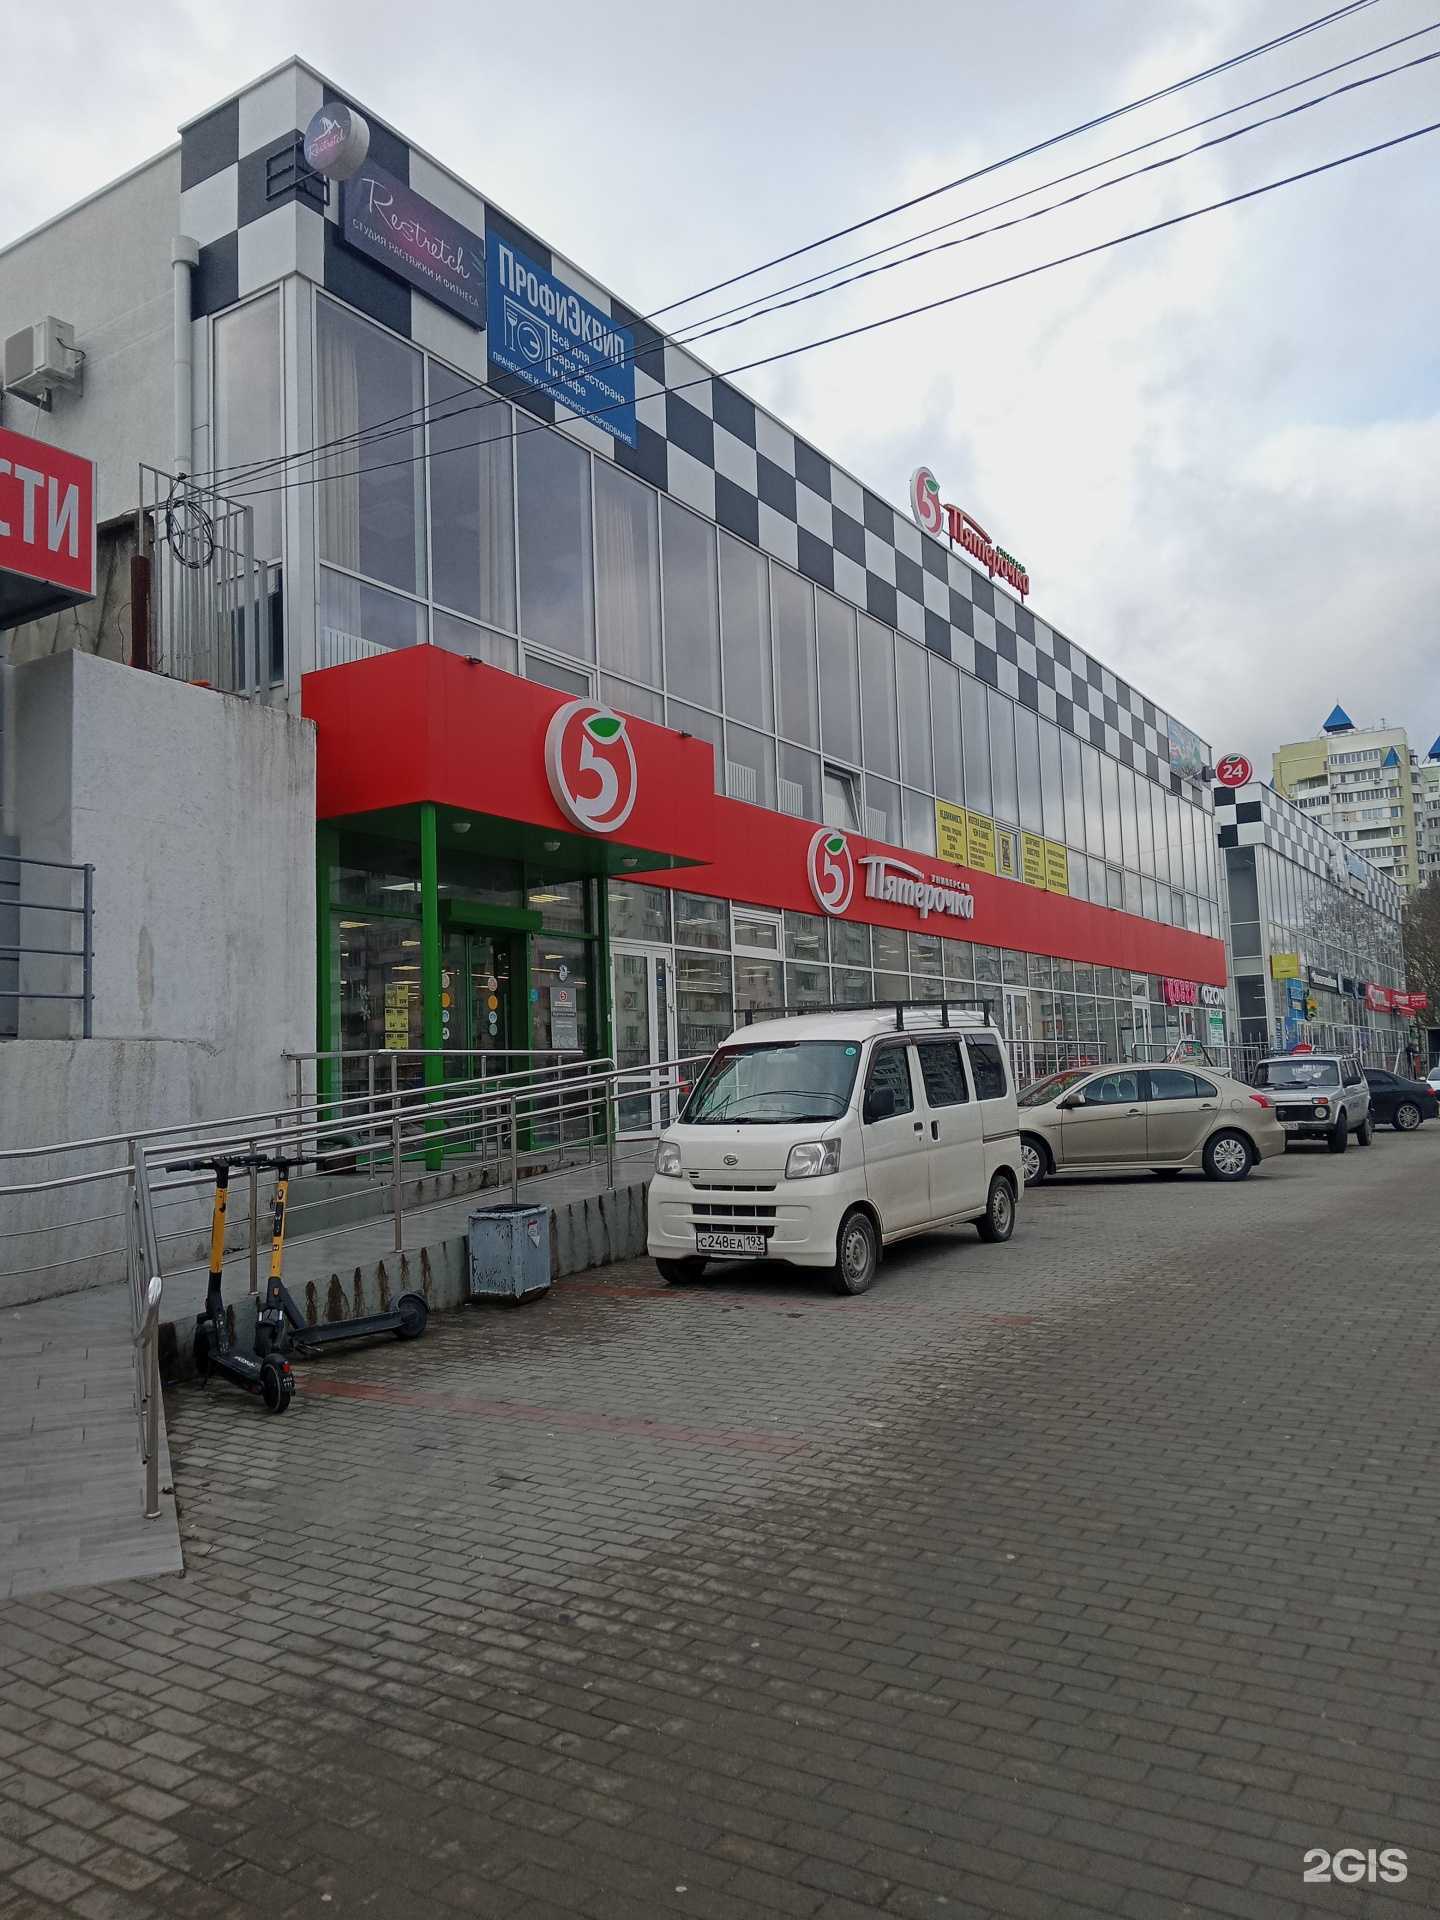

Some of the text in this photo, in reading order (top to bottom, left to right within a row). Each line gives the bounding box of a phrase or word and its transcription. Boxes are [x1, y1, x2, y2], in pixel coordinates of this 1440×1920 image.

[361, 178, 470, 279] Restretch
[353, 218, 480, 307] СТУДИЯ РАСТЯЖКИ И ФИТНЕСА
[943, 503, 1030, 595] Пятерочка
[1223, 764, 1244, 779] 24
[858, 854, 975, 920] Пятерочка
[1201, 985, 1225, 1006] OZON
[745, 1235, 762, 1247] 193
